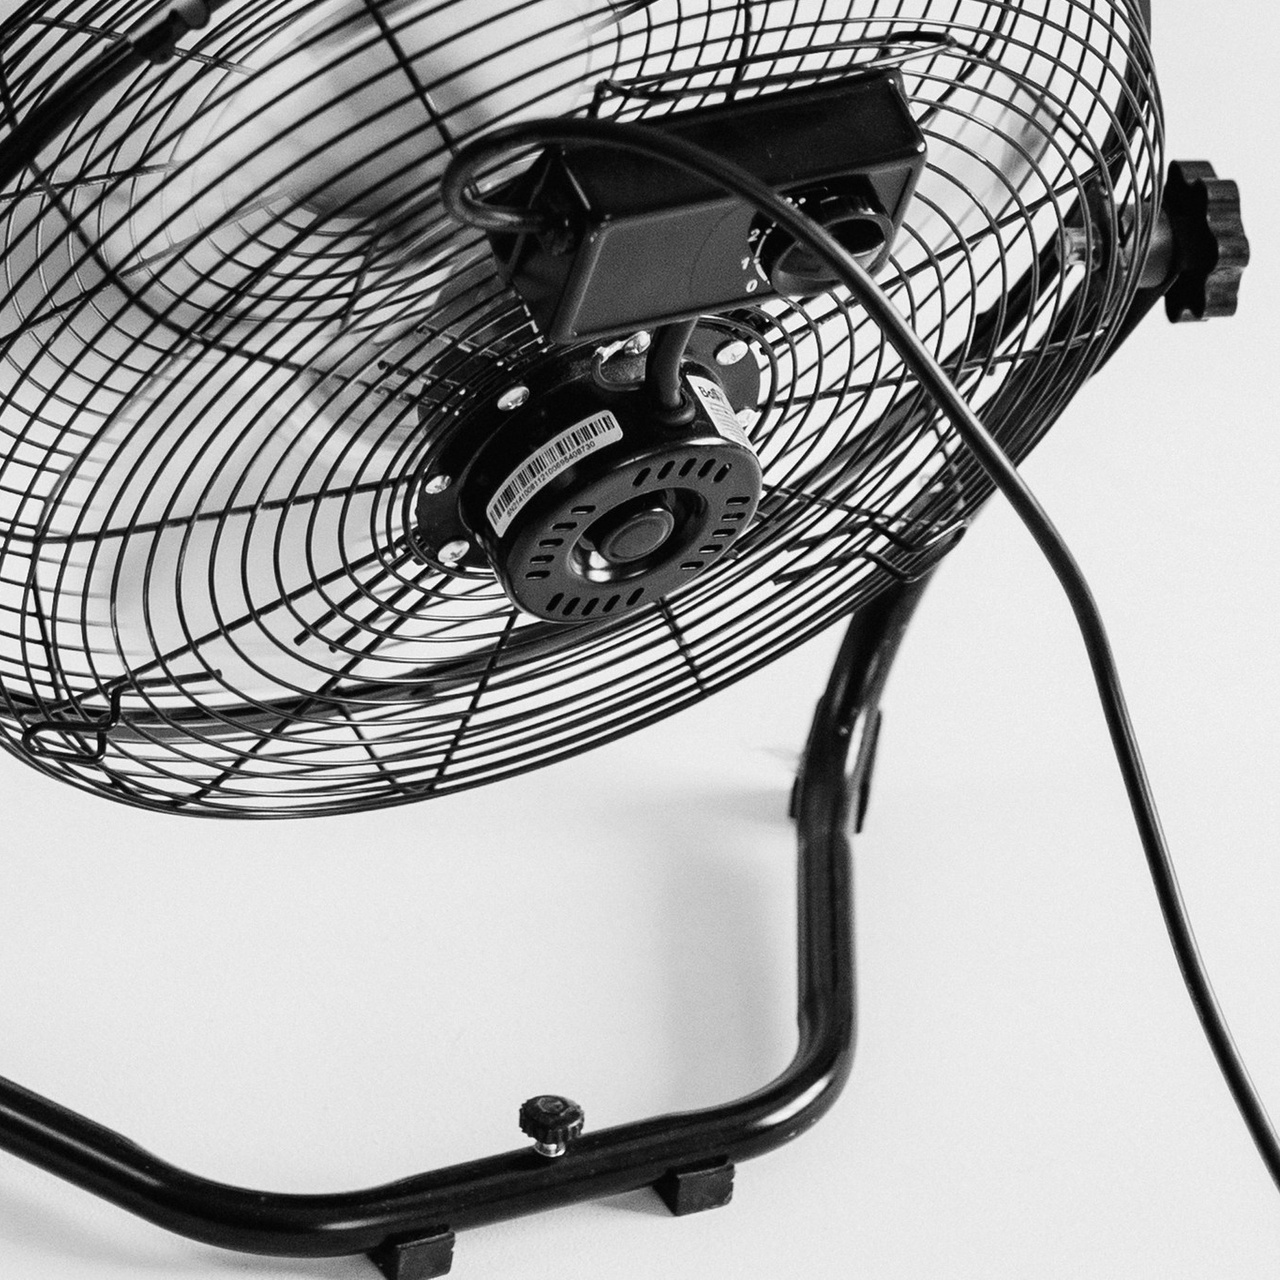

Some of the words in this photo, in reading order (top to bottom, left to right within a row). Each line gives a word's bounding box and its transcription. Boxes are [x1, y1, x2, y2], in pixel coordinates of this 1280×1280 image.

[747, 228, 761, 242] 2
[741, 256, 750, 270] 1
[746, 278, 758, 293] 0
